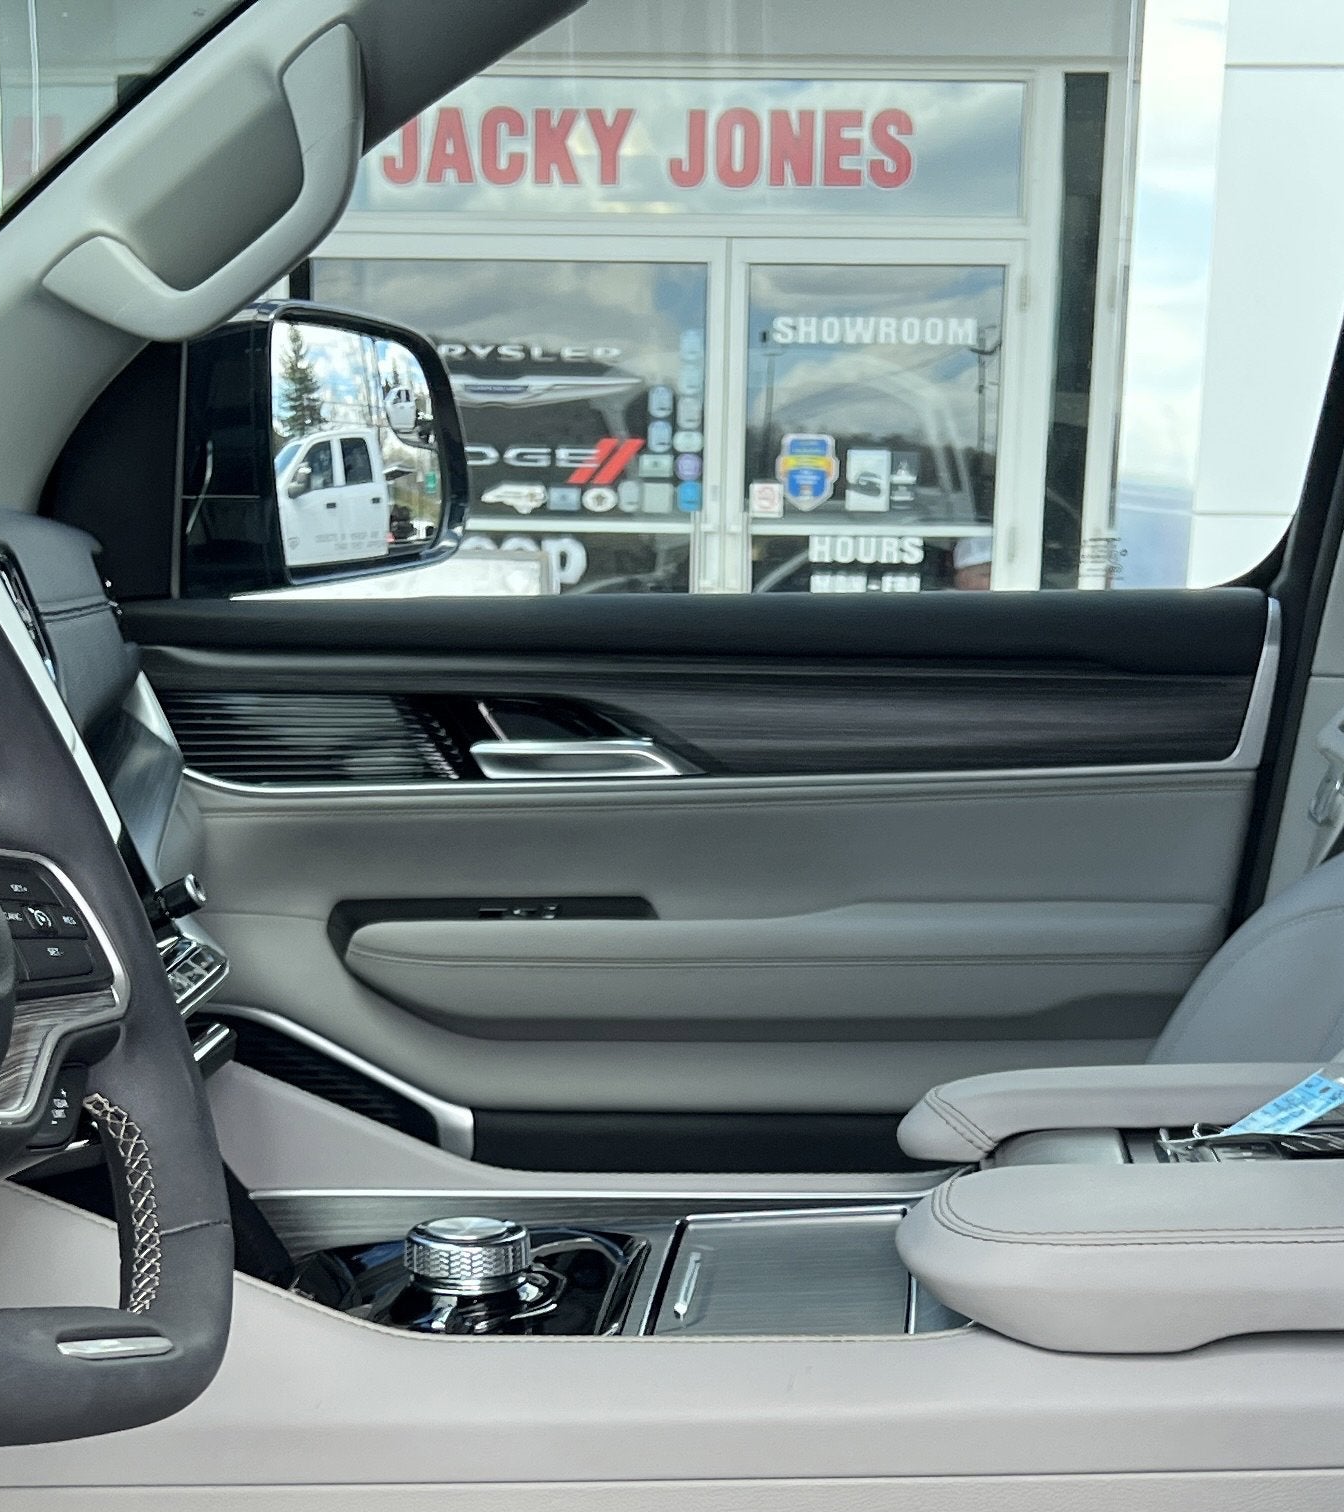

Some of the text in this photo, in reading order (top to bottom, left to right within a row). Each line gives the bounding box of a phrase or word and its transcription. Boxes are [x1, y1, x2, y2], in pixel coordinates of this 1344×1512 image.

[383, 105, 916, 189] JACKY JONES
[772, 316, 979, 345] SHOWROOM
[463, 446, 600, 467] DGE
[808, 536, 924, 564] HOURS
